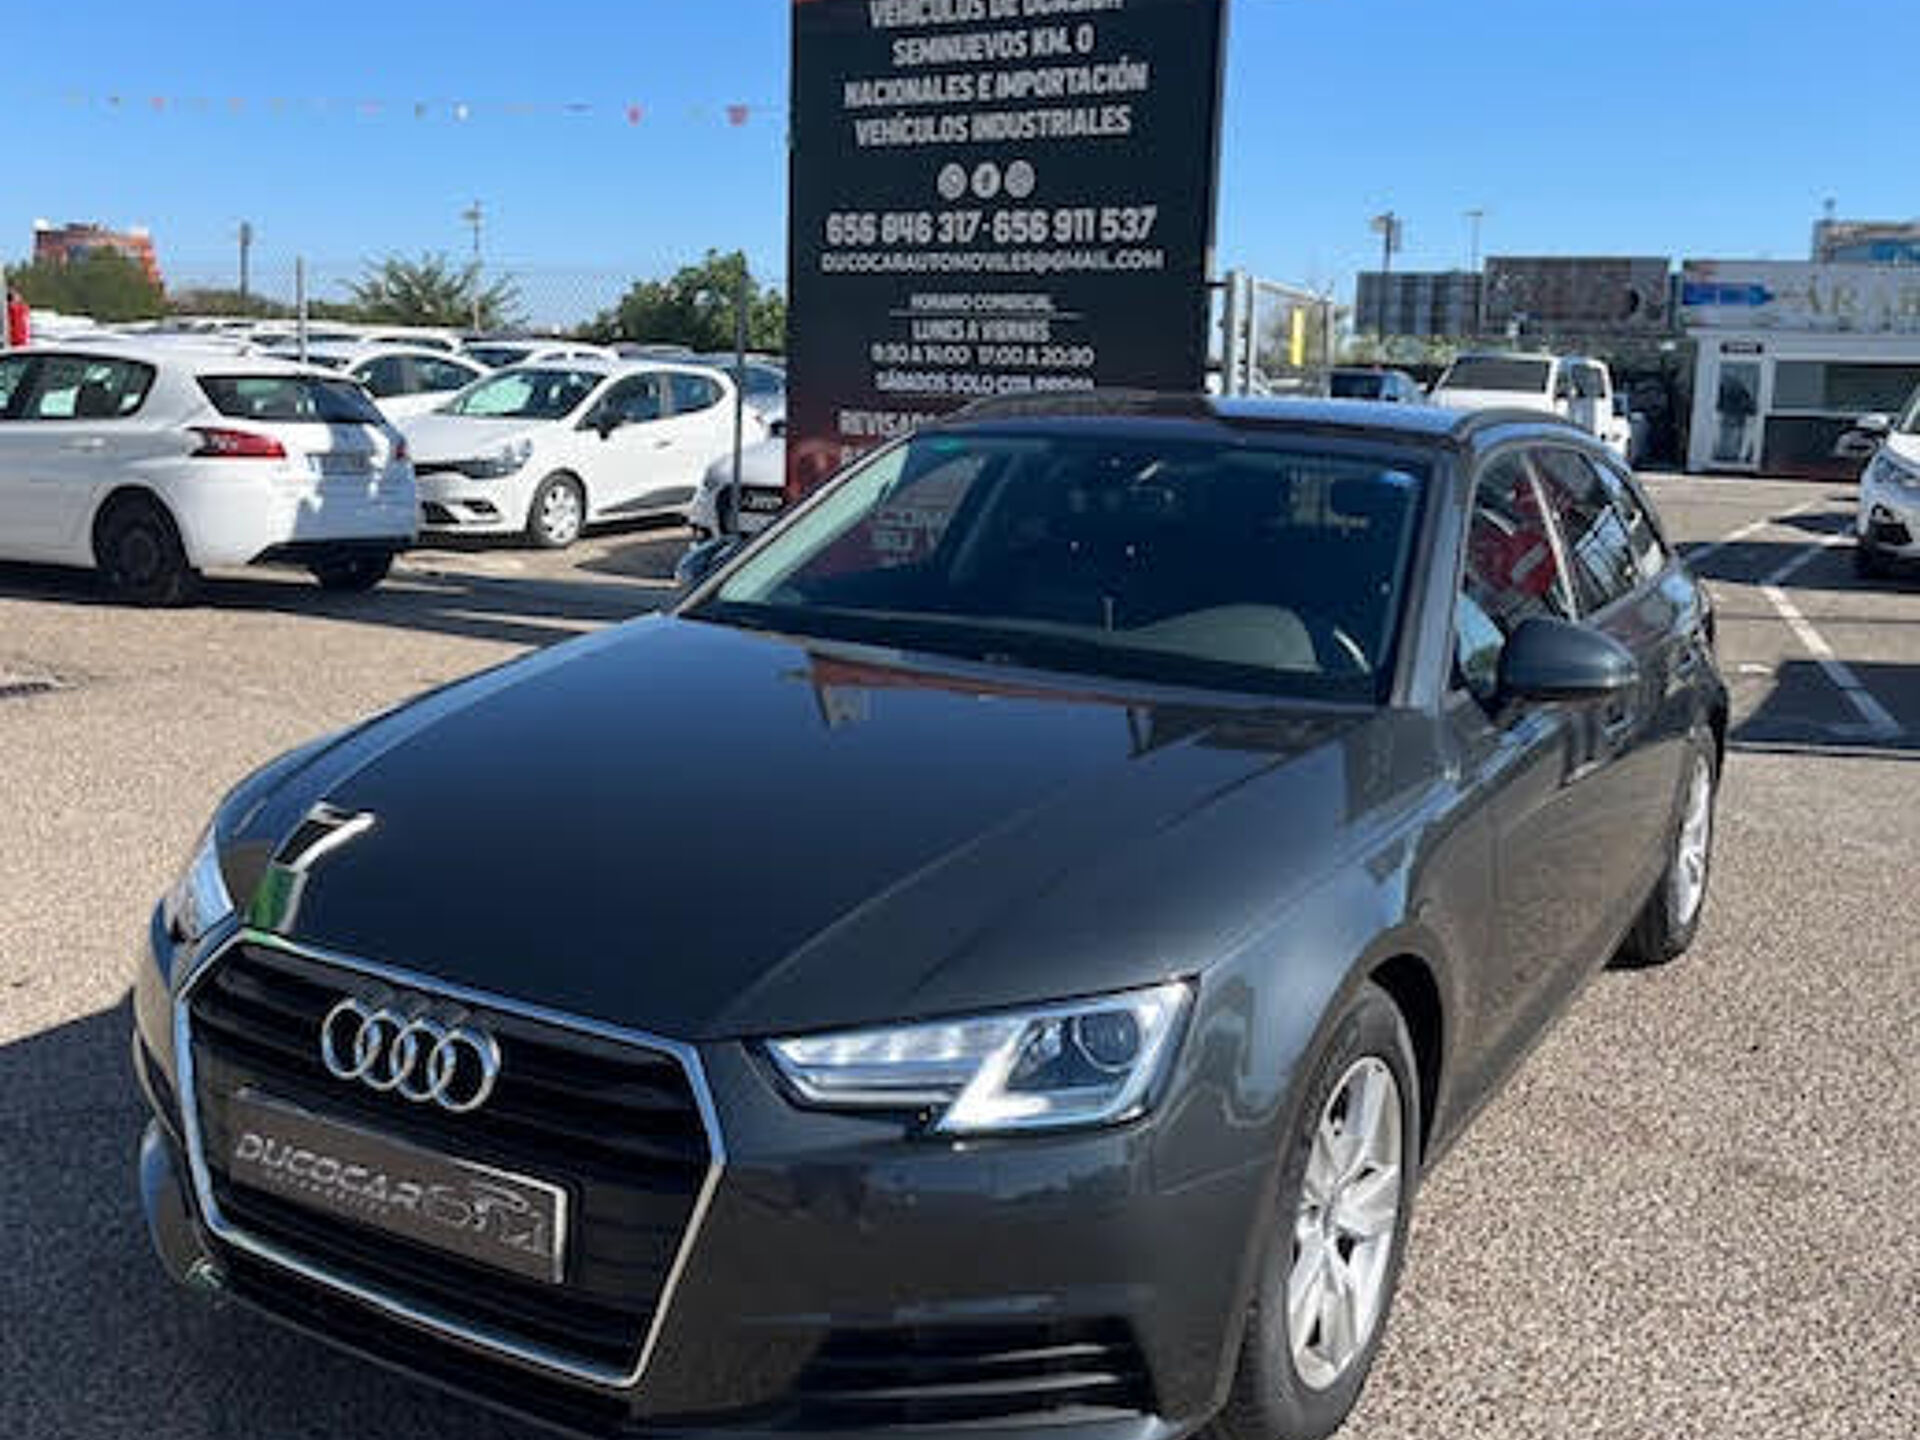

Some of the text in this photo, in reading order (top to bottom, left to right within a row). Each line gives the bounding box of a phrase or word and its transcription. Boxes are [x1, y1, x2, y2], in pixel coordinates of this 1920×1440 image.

[892, 31, 1027, 66] SEMINUEVOS
[844, 57, 1148, 108] NACIONALES E IMPORTACIÓN
[855, 105, 1131, 146] VEHÍCULOS INDUSTRIALES
[826, 212, 877, 245] 656
[881, 212, 932, 244] 846
[1053, 208, 1095, 241] 911
[1100, 206, 1157, 240] 537
[911, 319, 1051, 342] LUNES A VIERNES
[911, 343, 923, 362] A
[1026, 345, 1039, 366] A
[951, 372, 995, 394] SOLO
[236, 1132, 424, 1209] DUCOCAR
